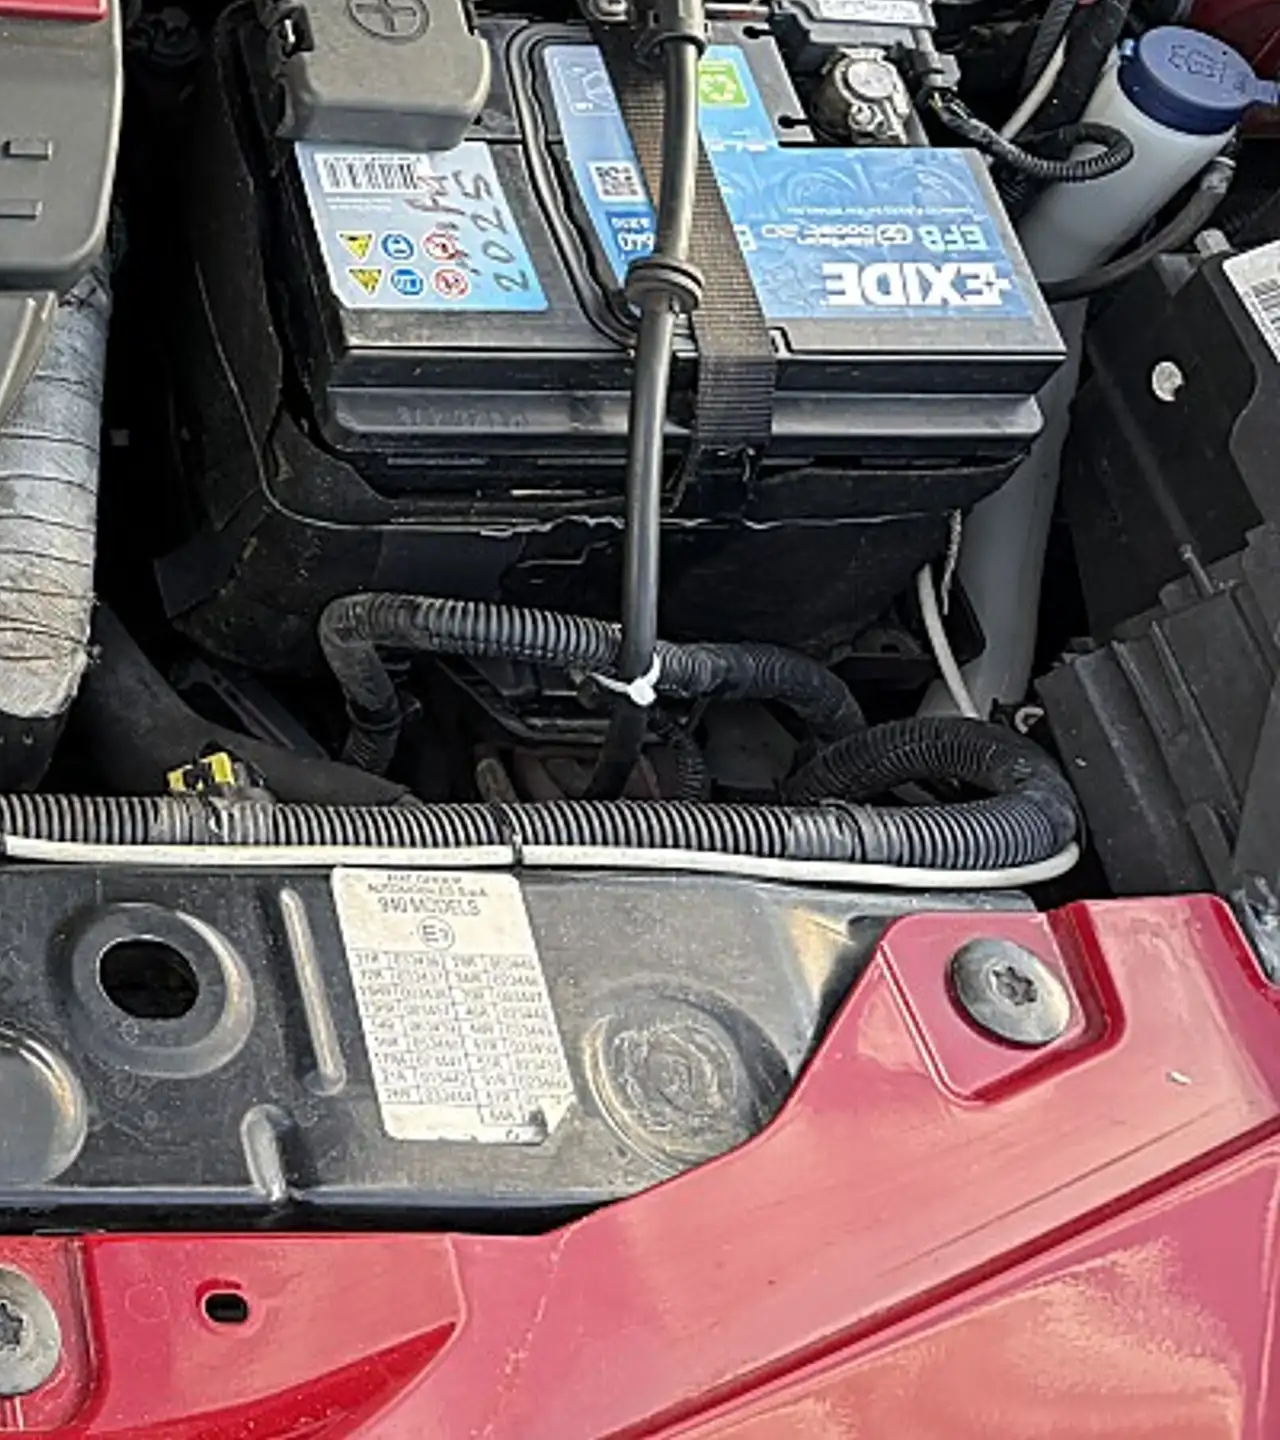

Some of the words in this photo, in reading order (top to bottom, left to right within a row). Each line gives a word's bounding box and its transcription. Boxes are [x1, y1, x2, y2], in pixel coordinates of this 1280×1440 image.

[452, 170, 529, 293] 2025
[918, 225, 988, 250] EFB
[822, 262, 1011, 306] EXIDE
